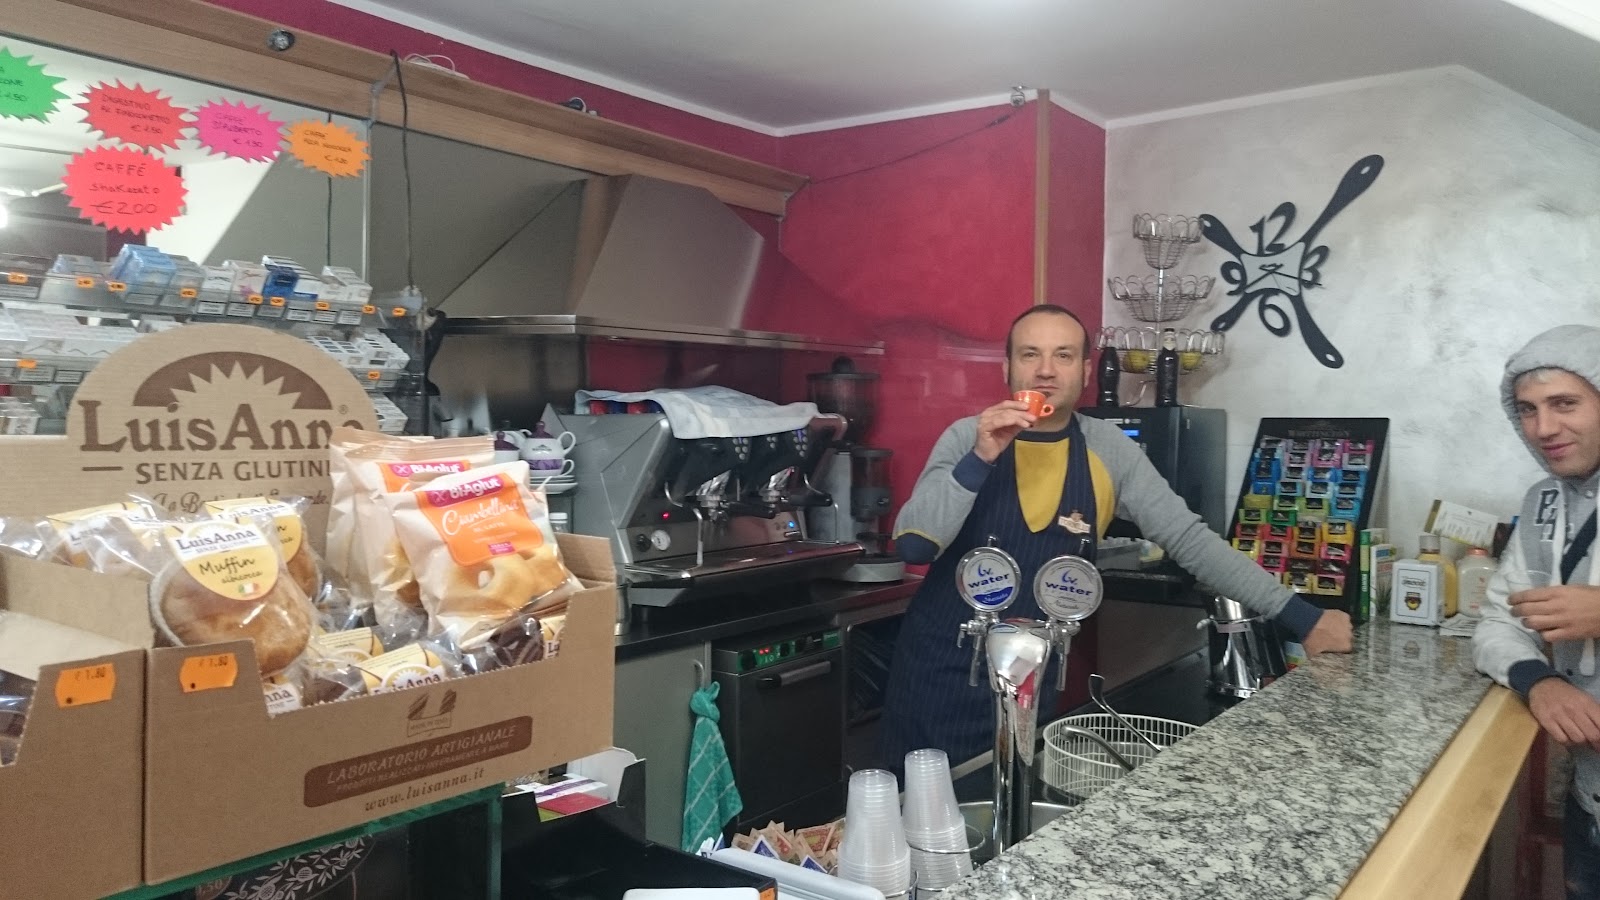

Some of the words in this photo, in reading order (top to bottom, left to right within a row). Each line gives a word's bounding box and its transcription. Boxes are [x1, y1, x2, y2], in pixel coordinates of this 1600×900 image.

[1249, 201, 1298, 255] 12
[1219, 261, 1247, 296] 9
[1302, 245, 1331, 290] 3
[1257, 292, 1292, 337] 6
[136, 461, 223, 485] SENZA
[234, 459, 331, 480] GLUTIN
[175, 528, 257, 551] LuisAnna
[198, 556, 255, 577] Muffin
[967, 573, 1010, 589] water
[1045, 581, 1093, 597] water
[327, 747, 427, 785] LABORATORIO
[430, 724, 518, 757] ARTIGIANALE
[365, 766, 486, 812] www.luisanna.it
